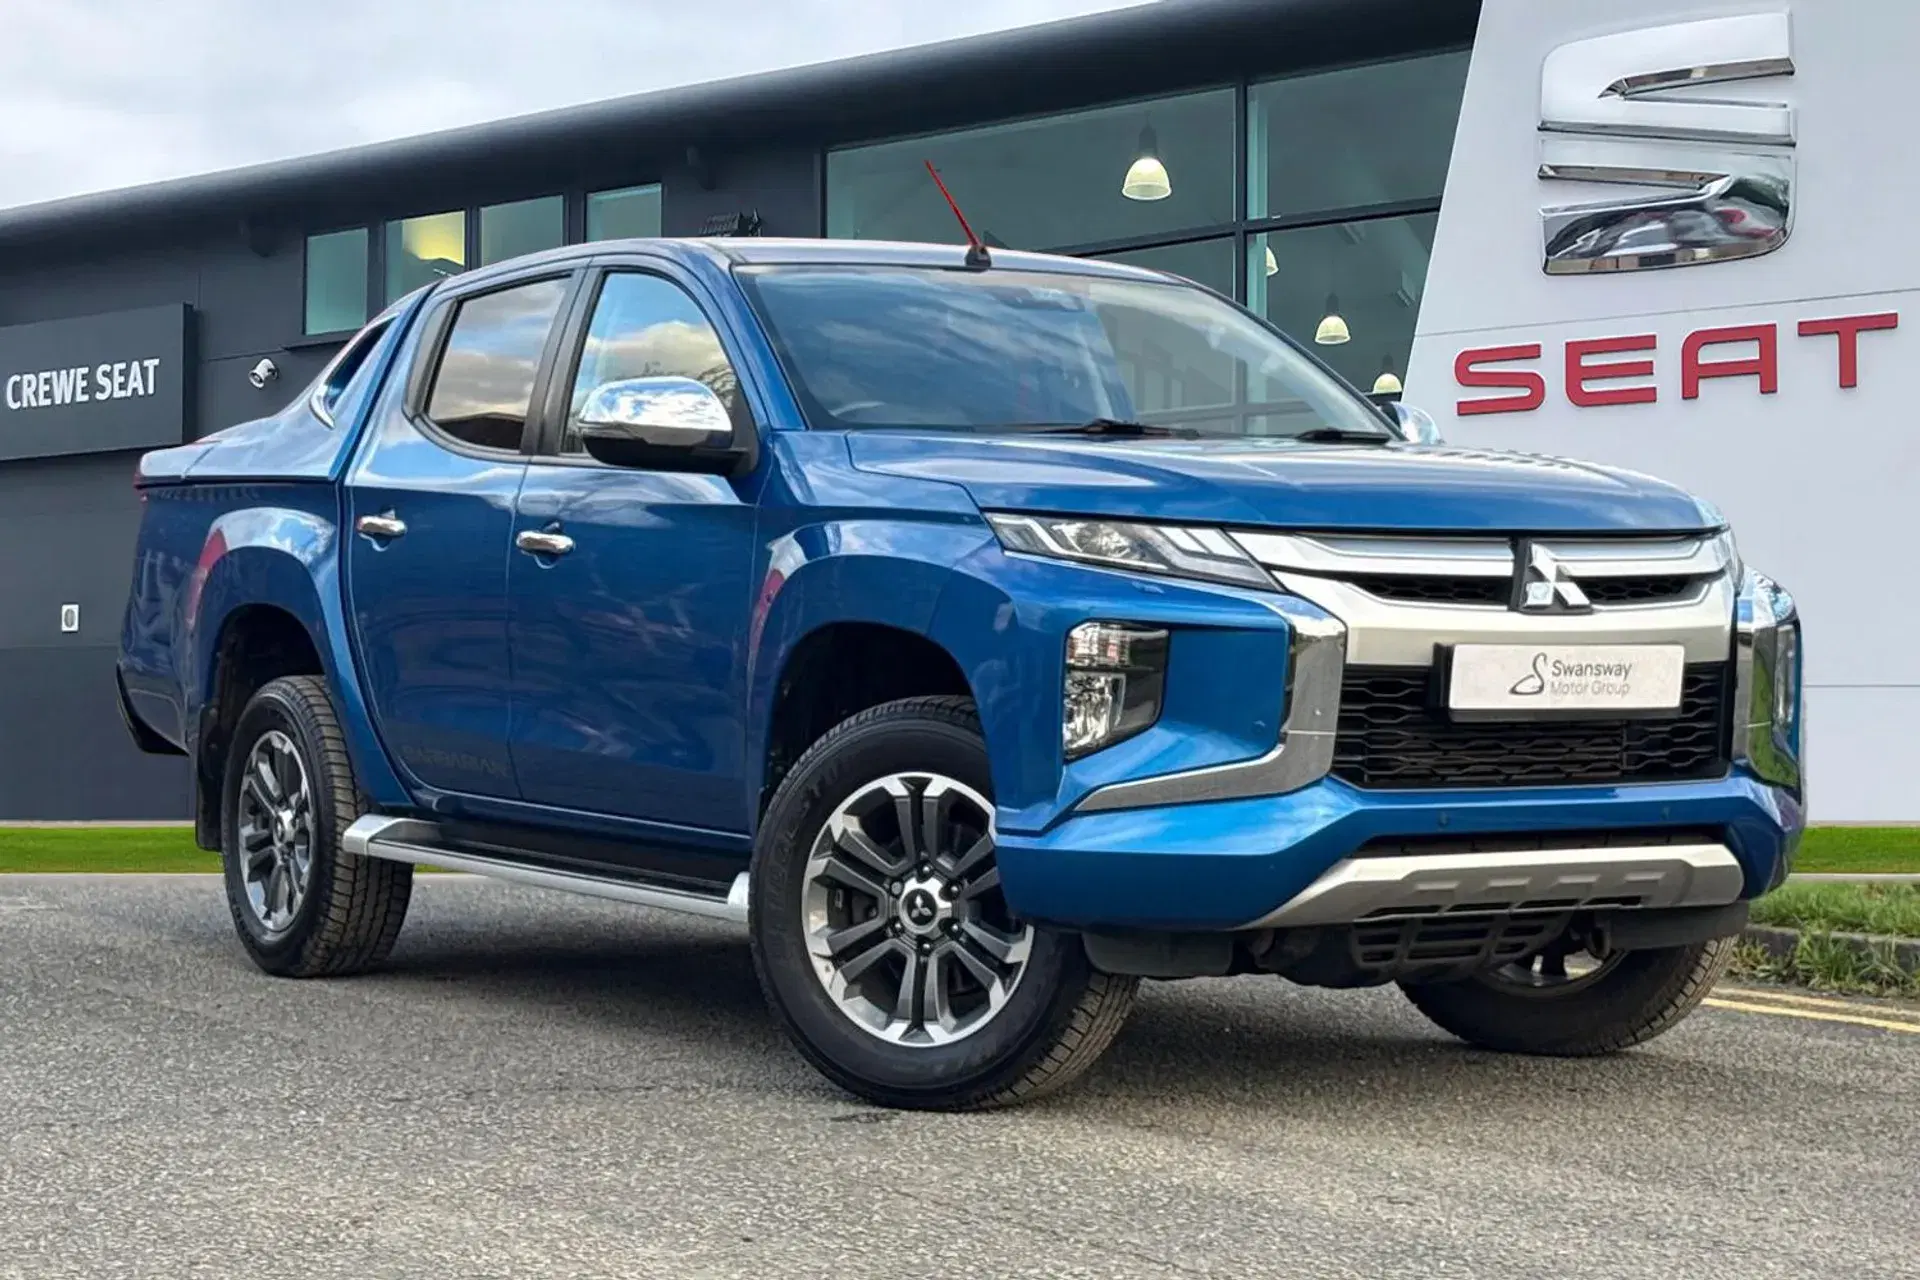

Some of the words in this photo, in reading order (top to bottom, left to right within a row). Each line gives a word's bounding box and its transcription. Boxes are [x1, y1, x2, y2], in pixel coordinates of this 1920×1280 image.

[1453, 312, 1899, 416] SEAT
[6, 366, 90, 410] CREWE
[95, 358, 160, 400] SEAT
[1551, 659, 1633, 681] Swansway
[1551, 681, 1589, 696] Motor
[1591, 680, 1631, 699] Group
